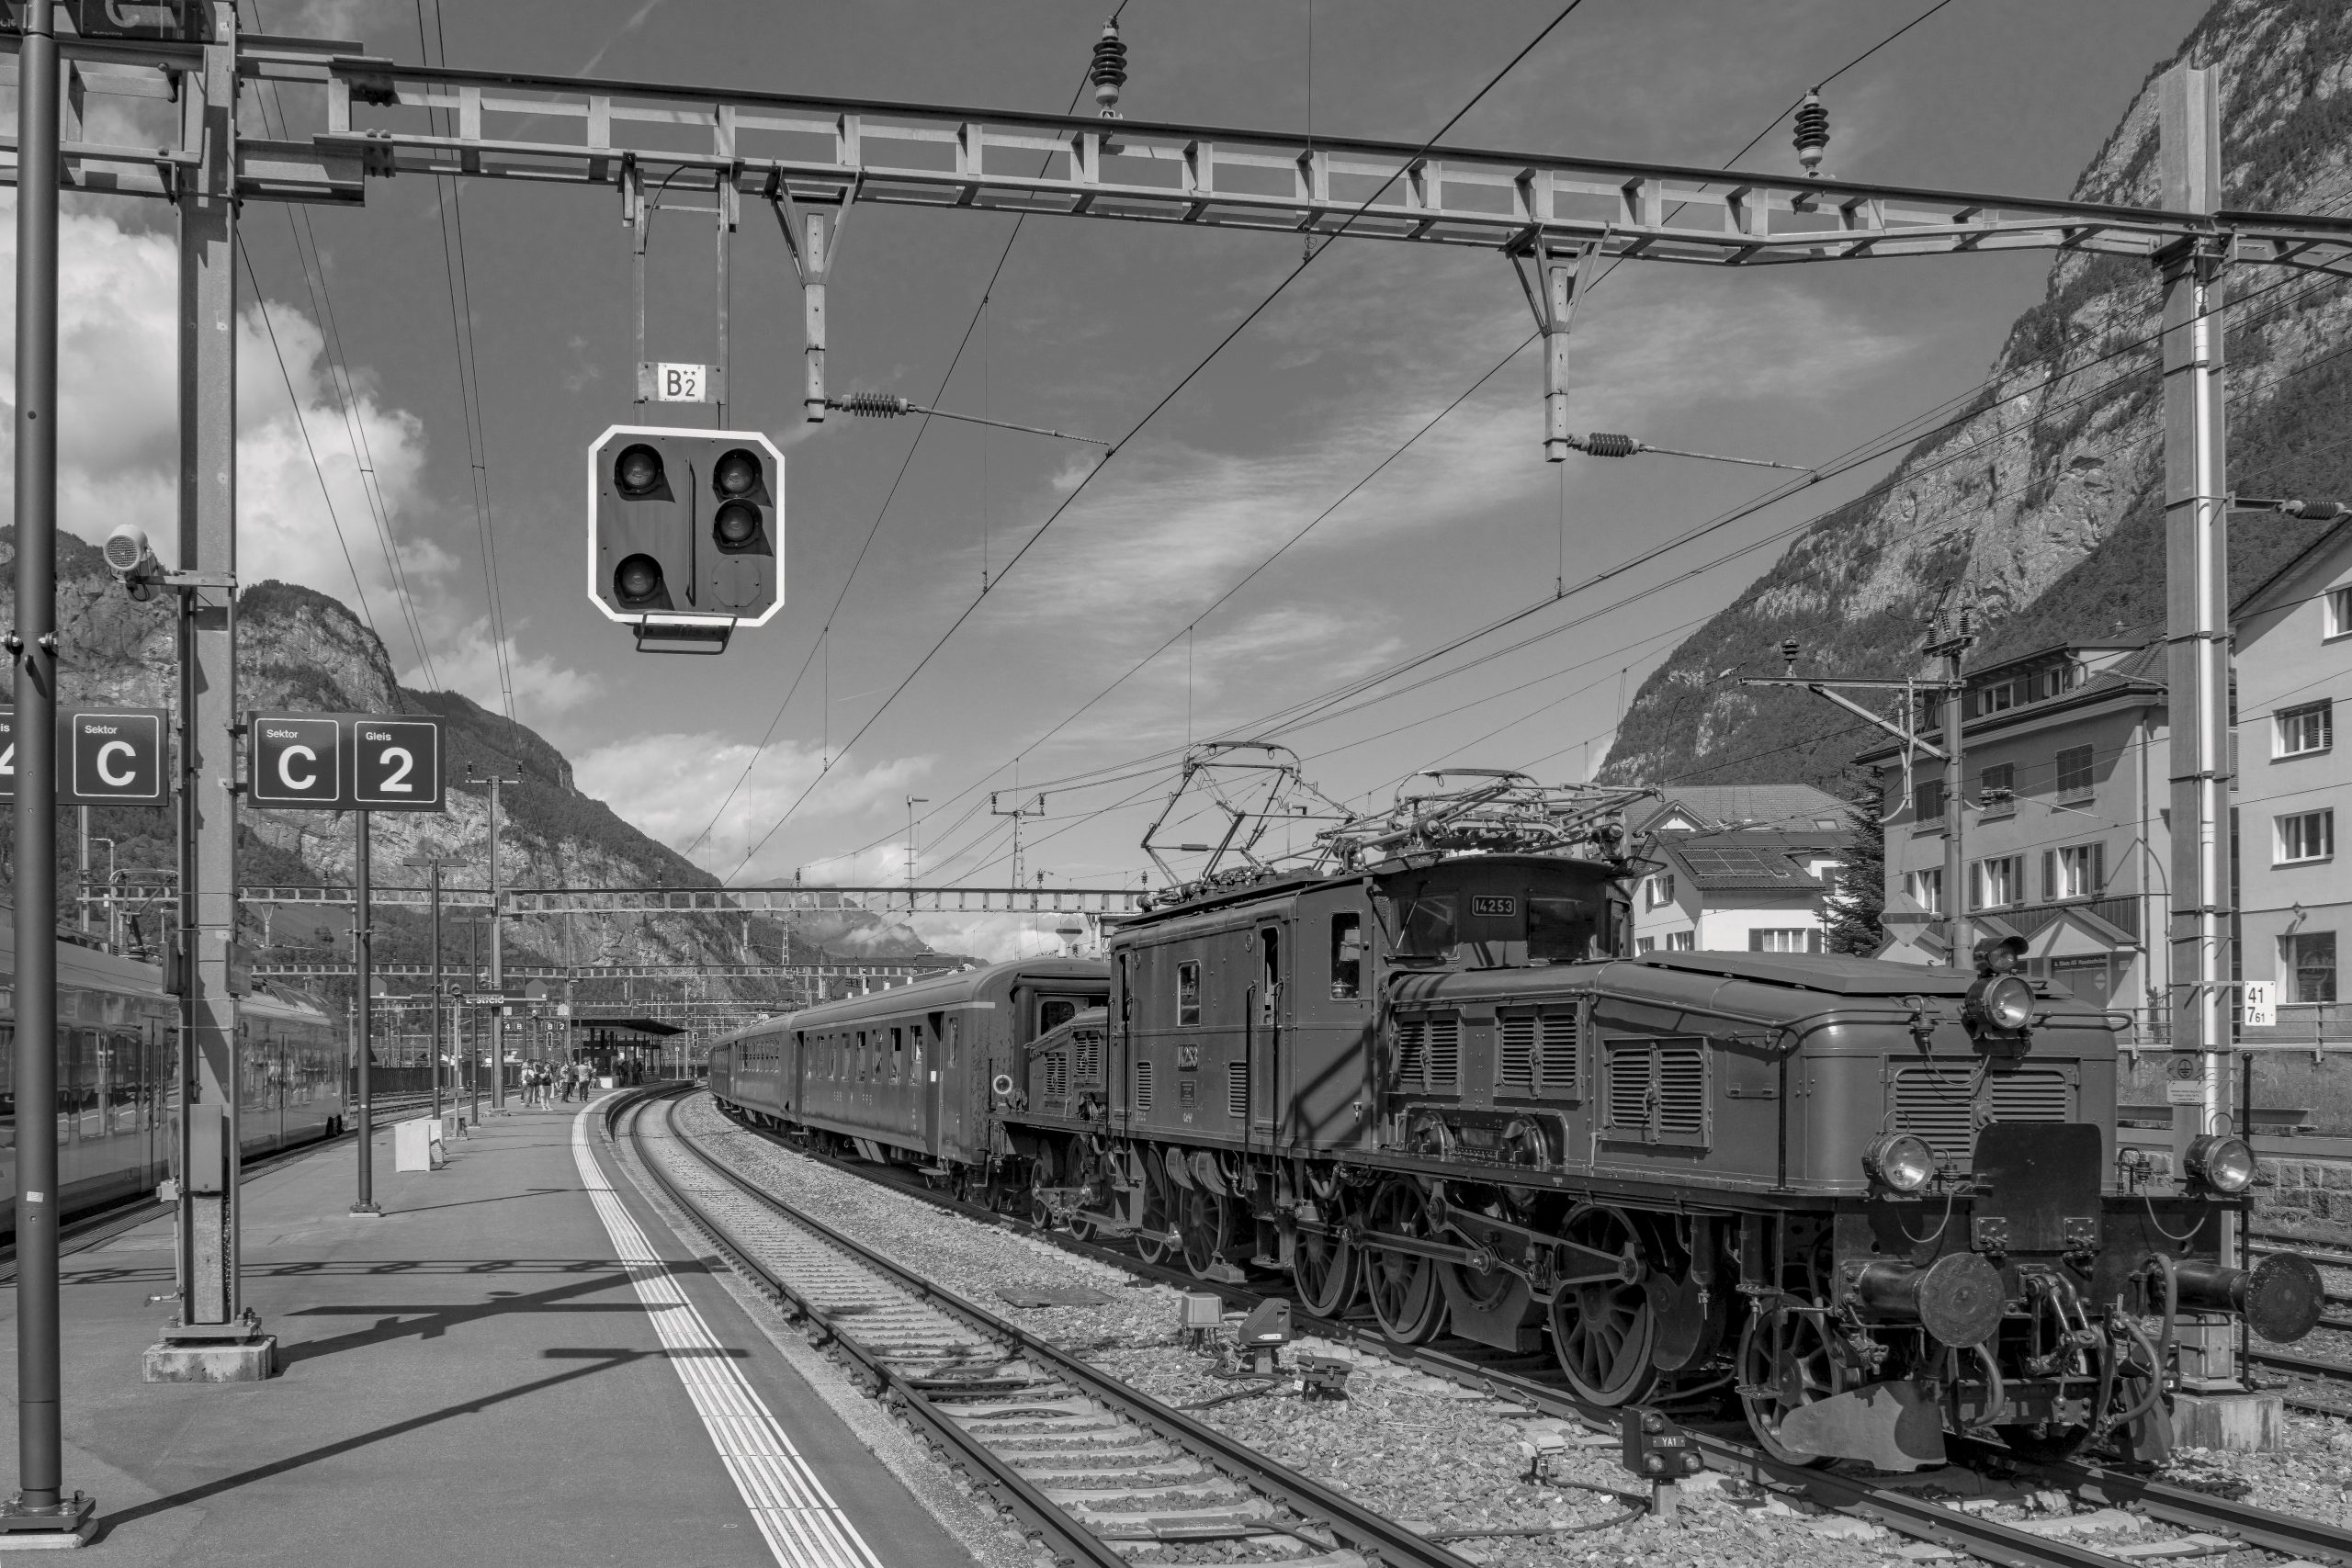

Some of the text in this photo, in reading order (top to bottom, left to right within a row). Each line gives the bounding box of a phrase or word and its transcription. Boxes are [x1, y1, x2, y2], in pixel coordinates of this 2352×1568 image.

[85, 725, 118, 735] Sektor
[266, 729, 392, 741] Sektor Gleis
[96, 740, 137, 786] C
[278, 745, 413, 793] C 2
[1476, 899, 1512, 912] 14253
[2247, 987, 2264, 1003] 41
[2247, 1006, 2265, 1022] 761
[1662, 1437, 1677, 1447] YA1
